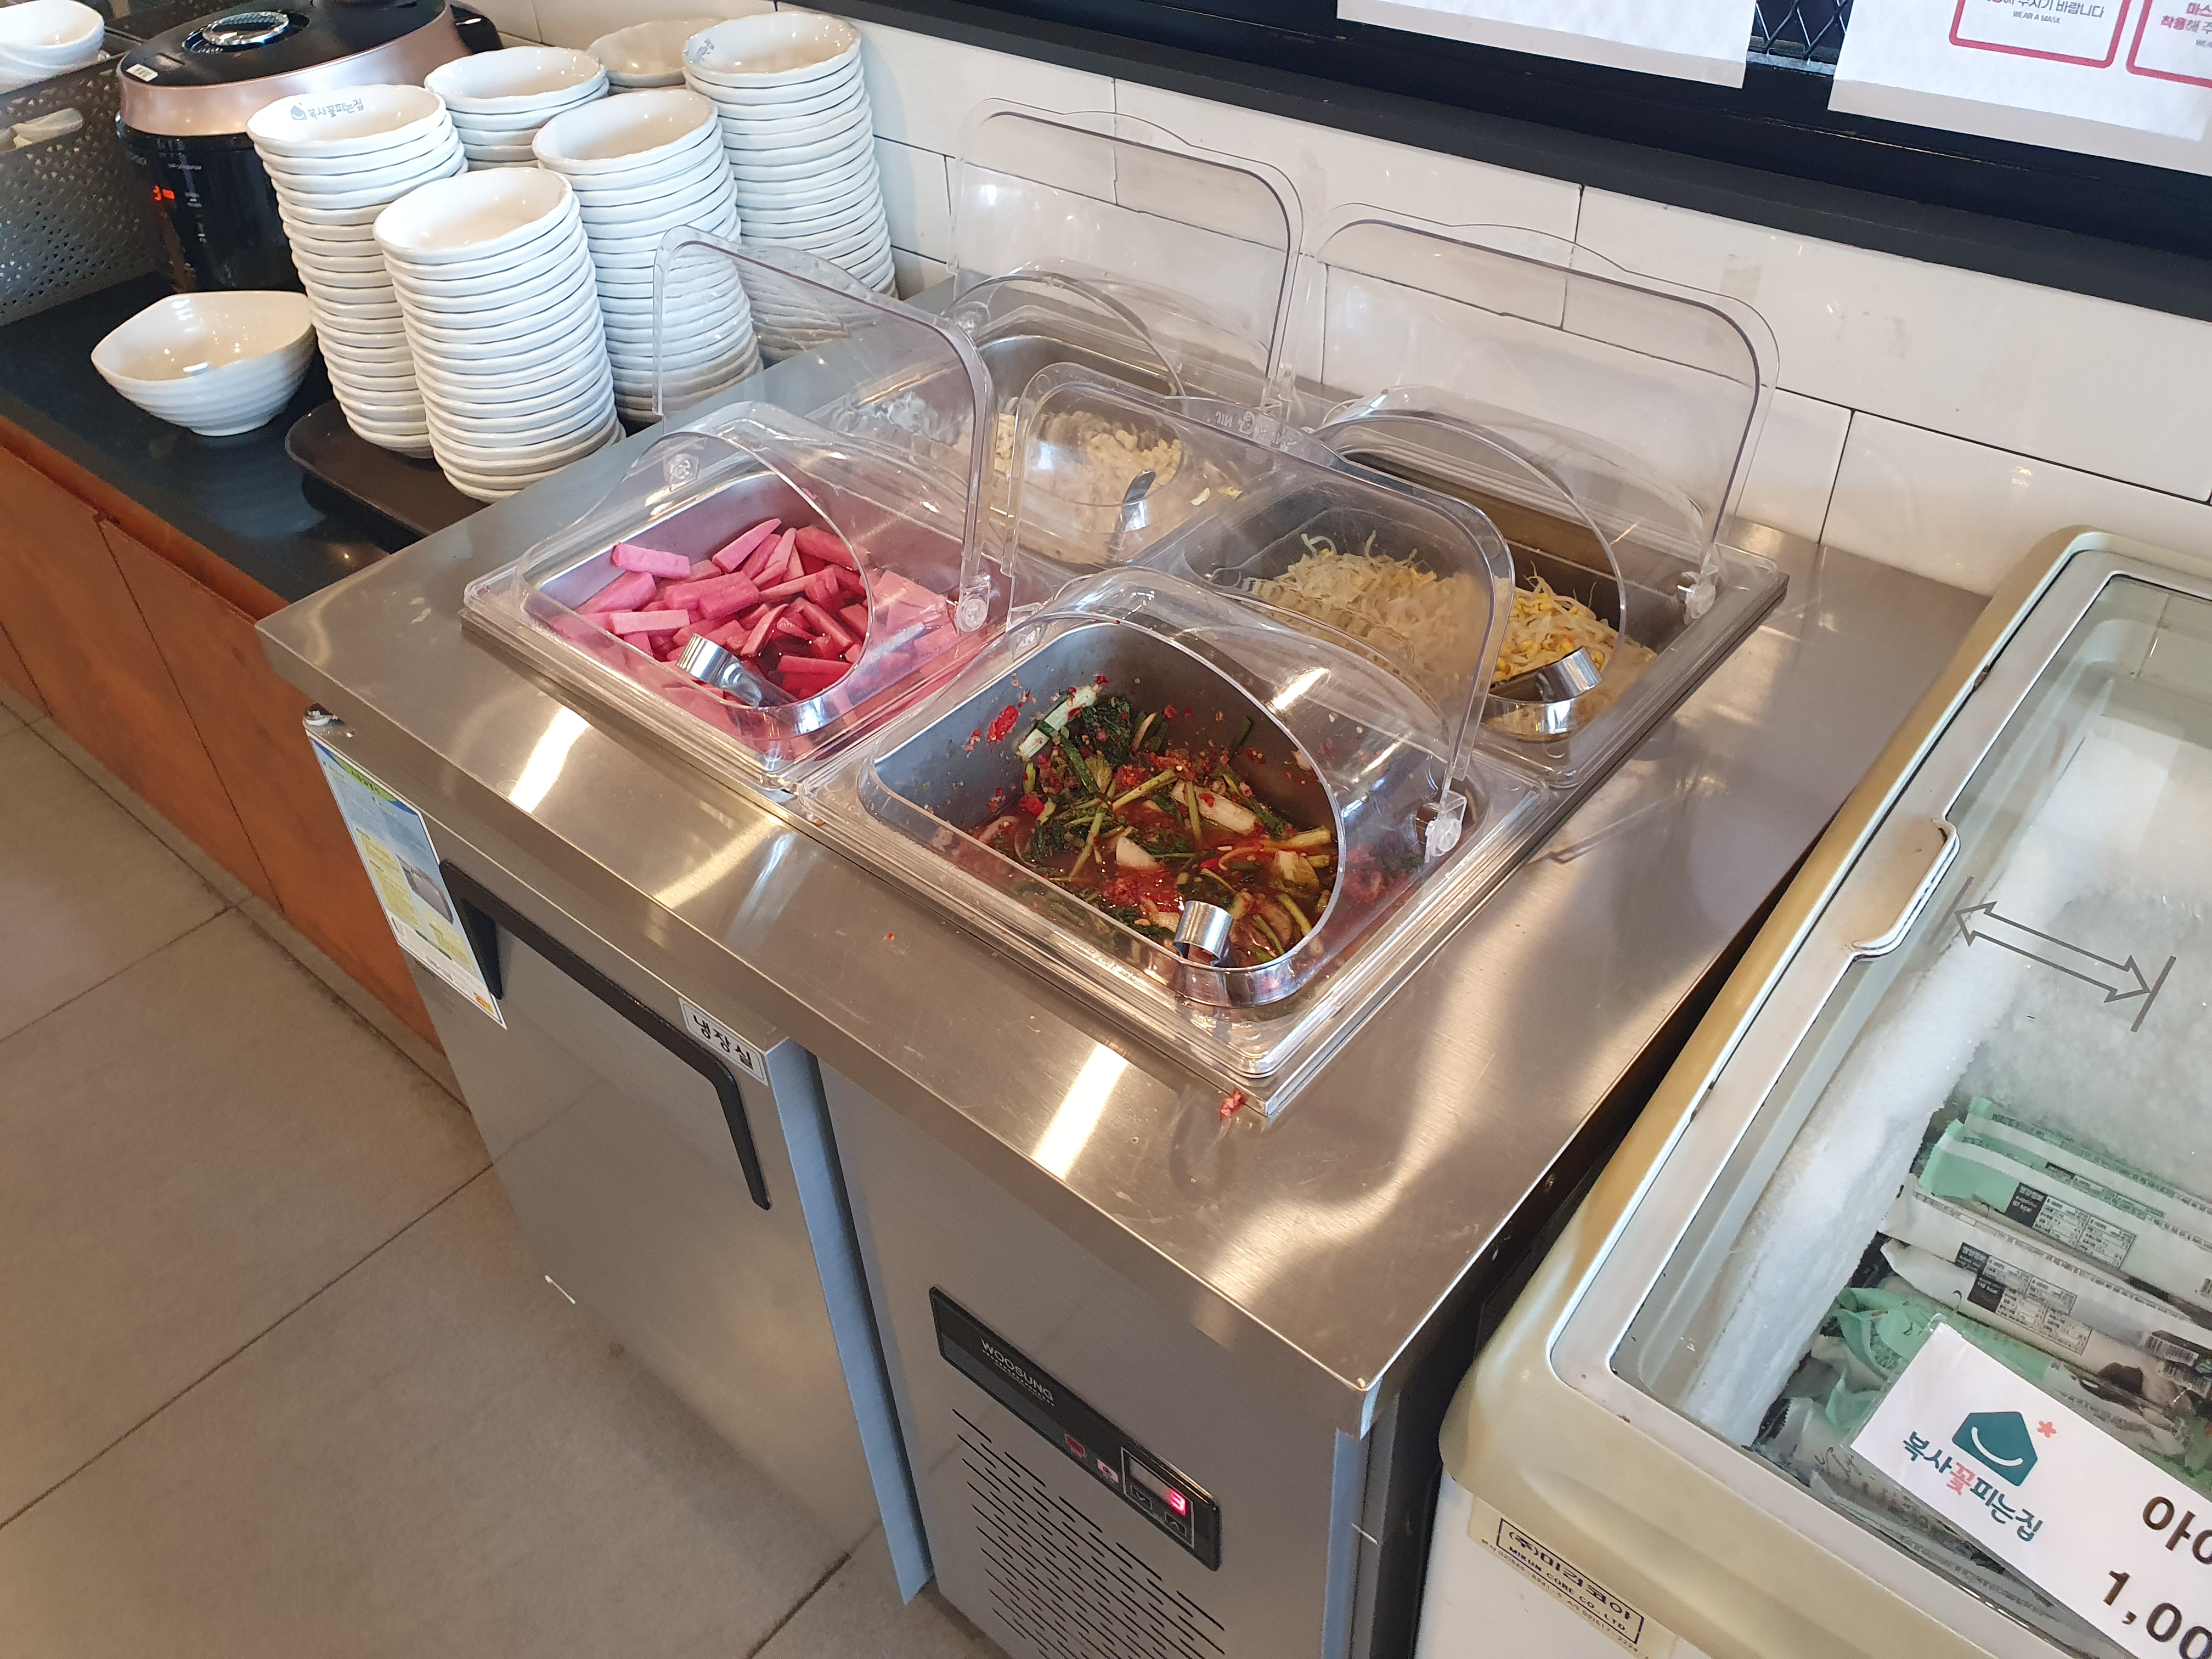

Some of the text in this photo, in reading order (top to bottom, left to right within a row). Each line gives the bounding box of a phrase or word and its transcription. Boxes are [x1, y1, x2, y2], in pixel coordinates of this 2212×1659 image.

[2013, 10, 2033, 19] WEAR
[2041, 15, 2061, 24] MASK
[2056, 1, 2104, 18] 바랍니다
[693, 1014, 754, 1070] 냉장실
[981, 1338, 1053, 1401] WOOSUNG
[1170, 1489, 1186, 1516] 3
[1903, 1431, 2044, 1542] 복사꽃피는집
[1509, 1546, 1542, 1572] MIKUN
[1547, 1573, 1576, 1595] CORE
